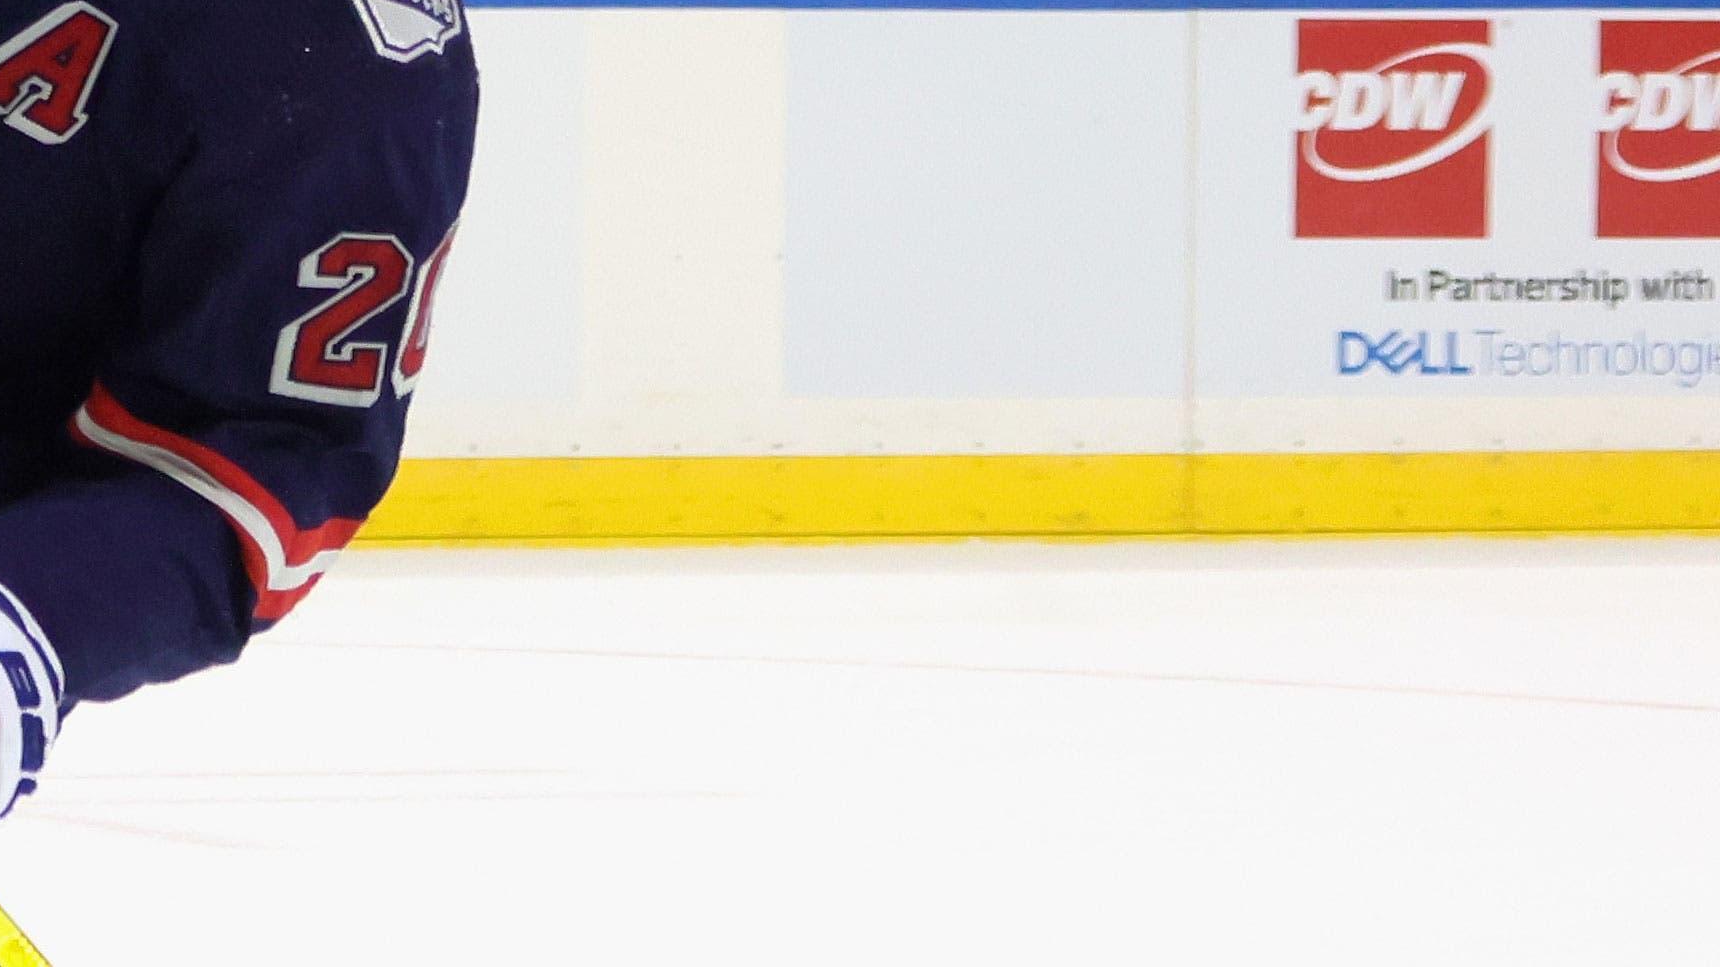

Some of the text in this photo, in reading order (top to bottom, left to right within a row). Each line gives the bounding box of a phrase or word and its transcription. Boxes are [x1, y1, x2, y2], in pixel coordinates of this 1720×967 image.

[1293, 70, 1467, 132] CDW
[1386, 269, 1715, 311] In Partnership with
[1337, 329, 1720, 388] DELL Technologi
